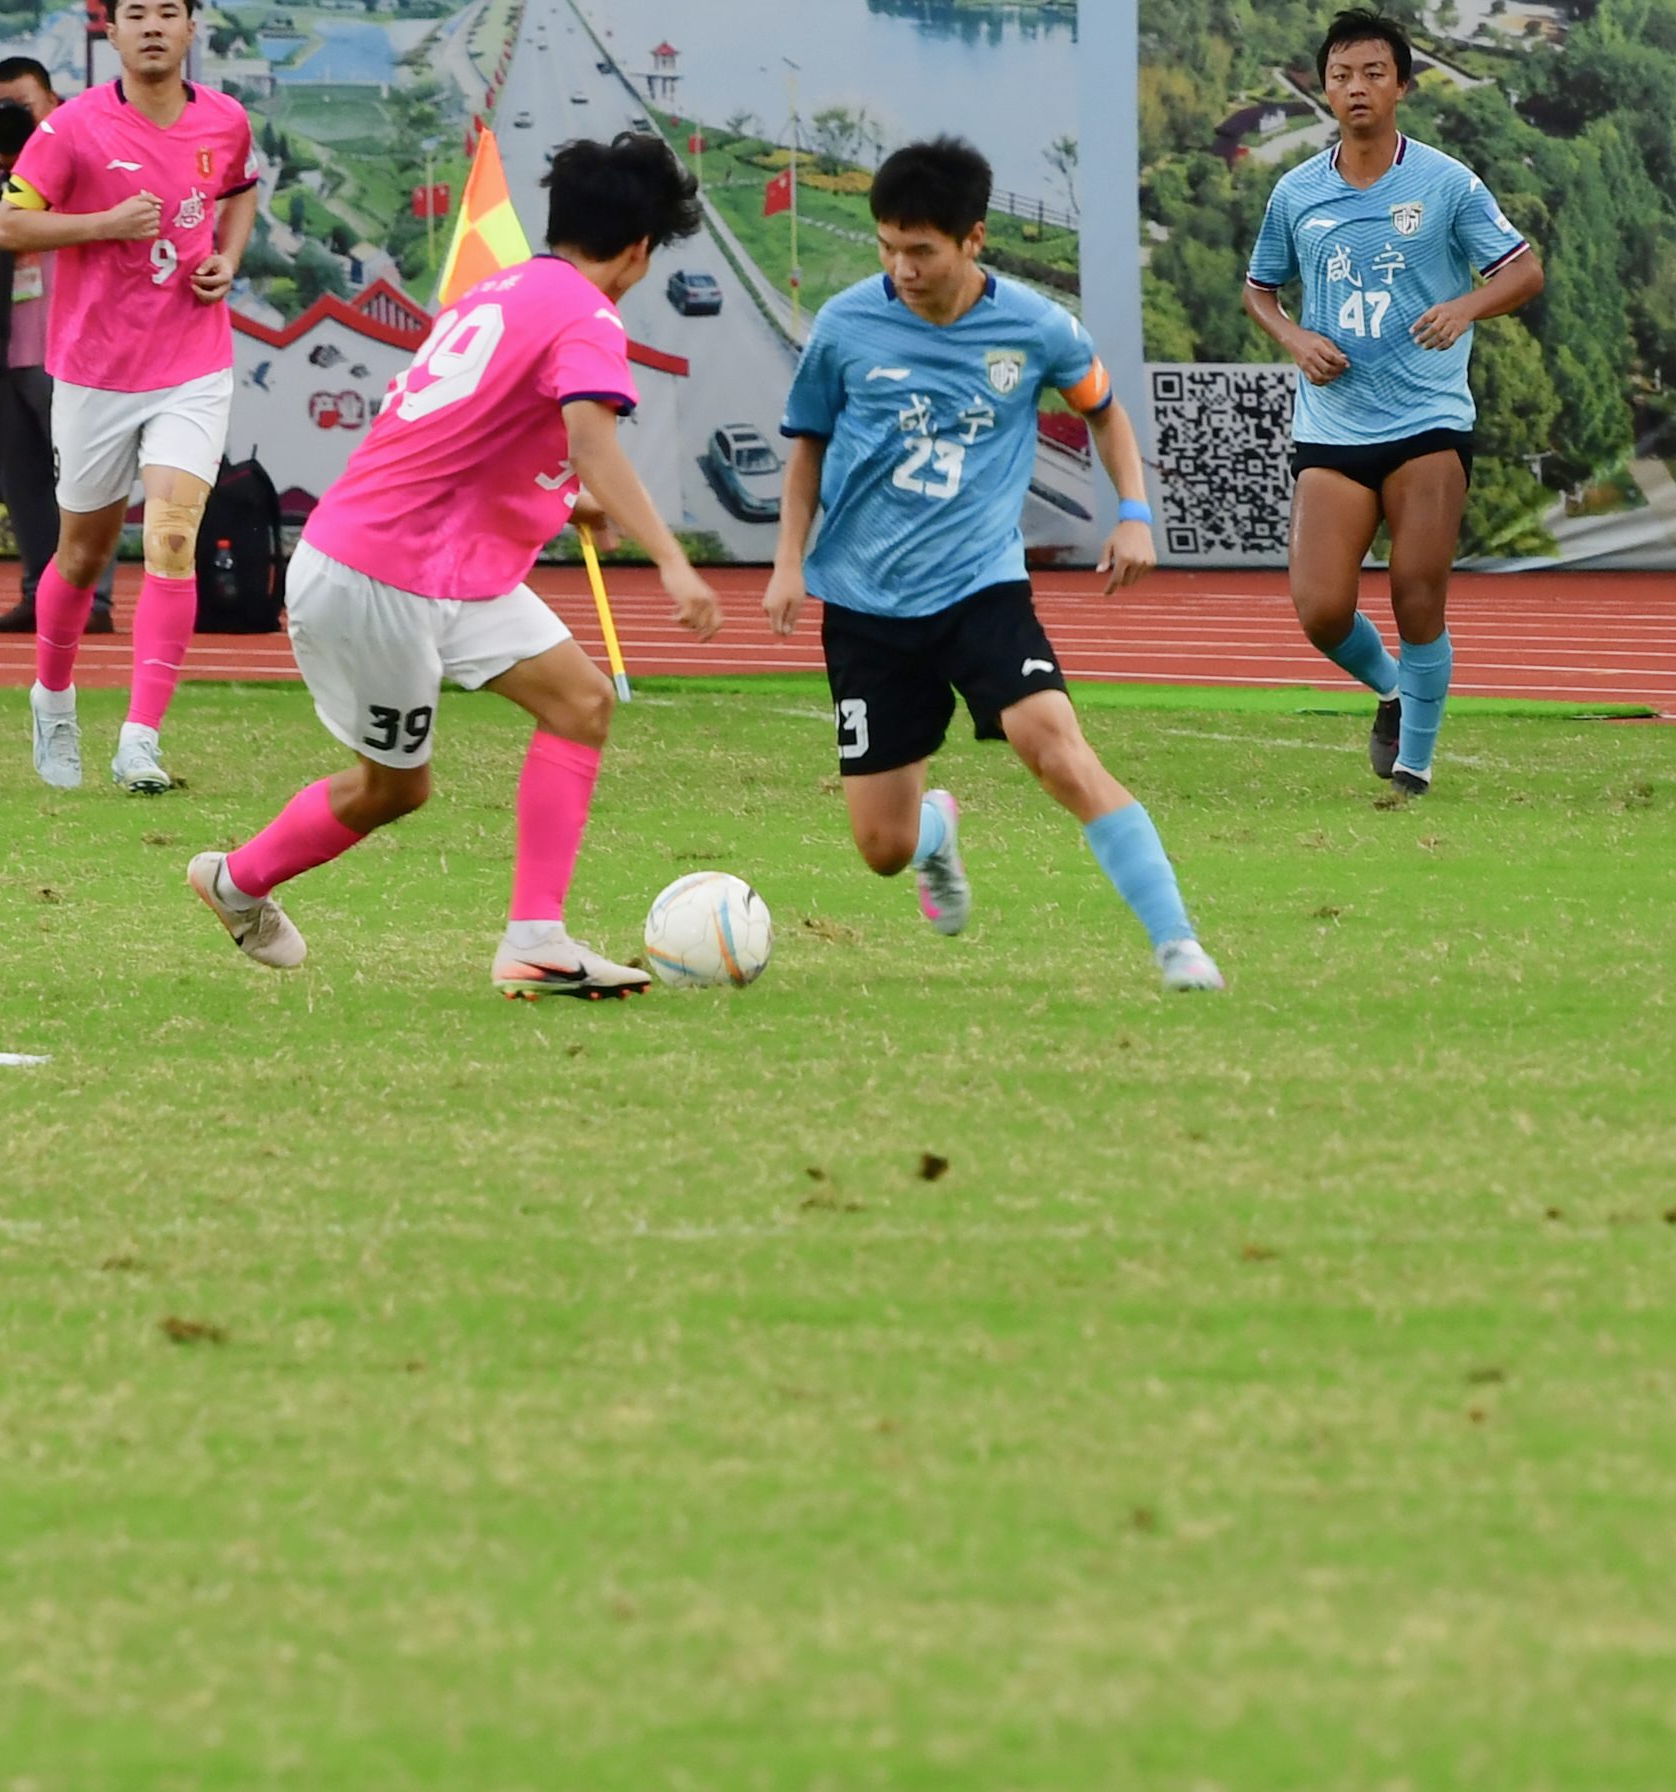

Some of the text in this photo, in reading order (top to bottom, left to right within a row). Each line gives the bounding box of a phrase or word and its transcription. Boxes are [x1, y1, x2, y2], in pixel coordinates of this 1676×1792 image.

[150, 239, 178, 285] 9
[1326, 244, 1406, 286] 咸宁
[1338, 291, 1392, 338] 47
[892, 437, 966, 499] 23
[362, 704, 432, 754] 39
[835, 697, 870, 760] 3
